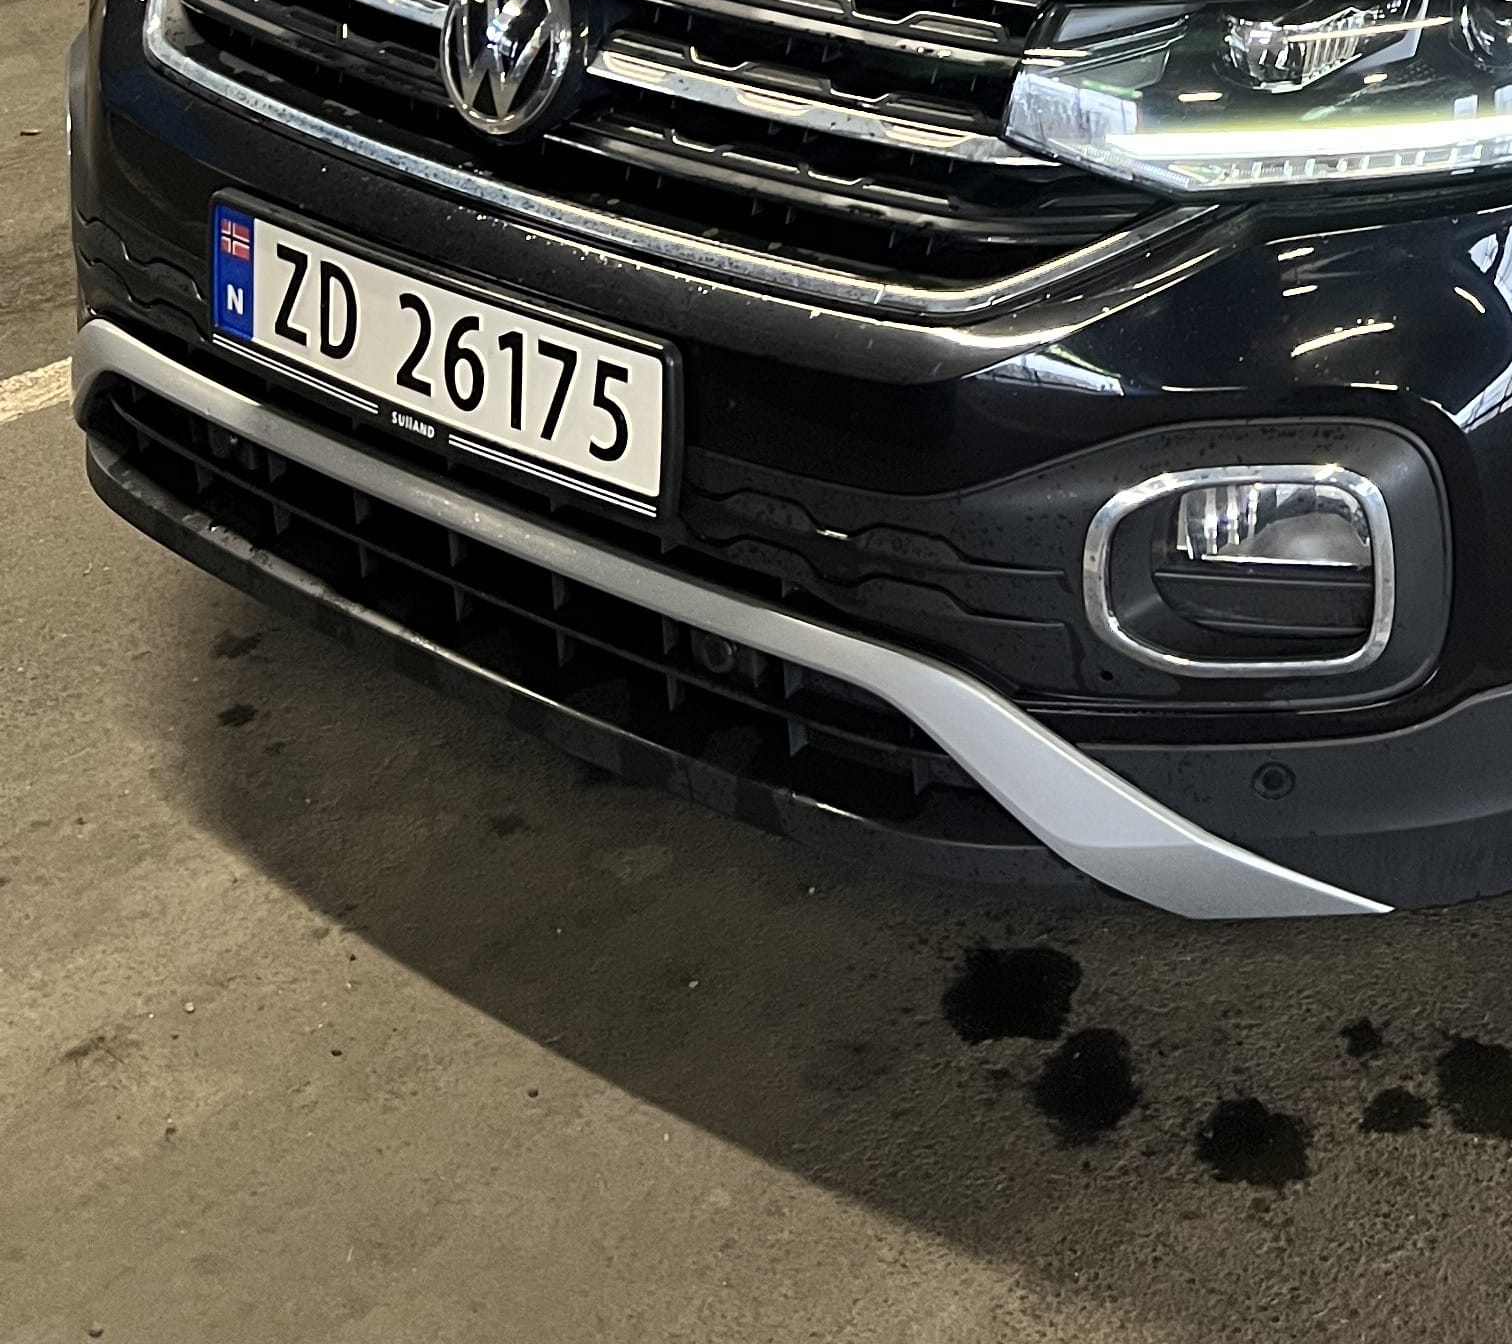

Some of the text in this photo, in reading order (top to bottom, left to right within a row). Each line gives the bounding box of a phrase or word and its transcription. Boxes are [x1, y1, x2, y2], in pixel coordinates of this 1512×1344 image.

[227, 283, 244, 315] N
[274, 242, 630, 462] ZD 26175
